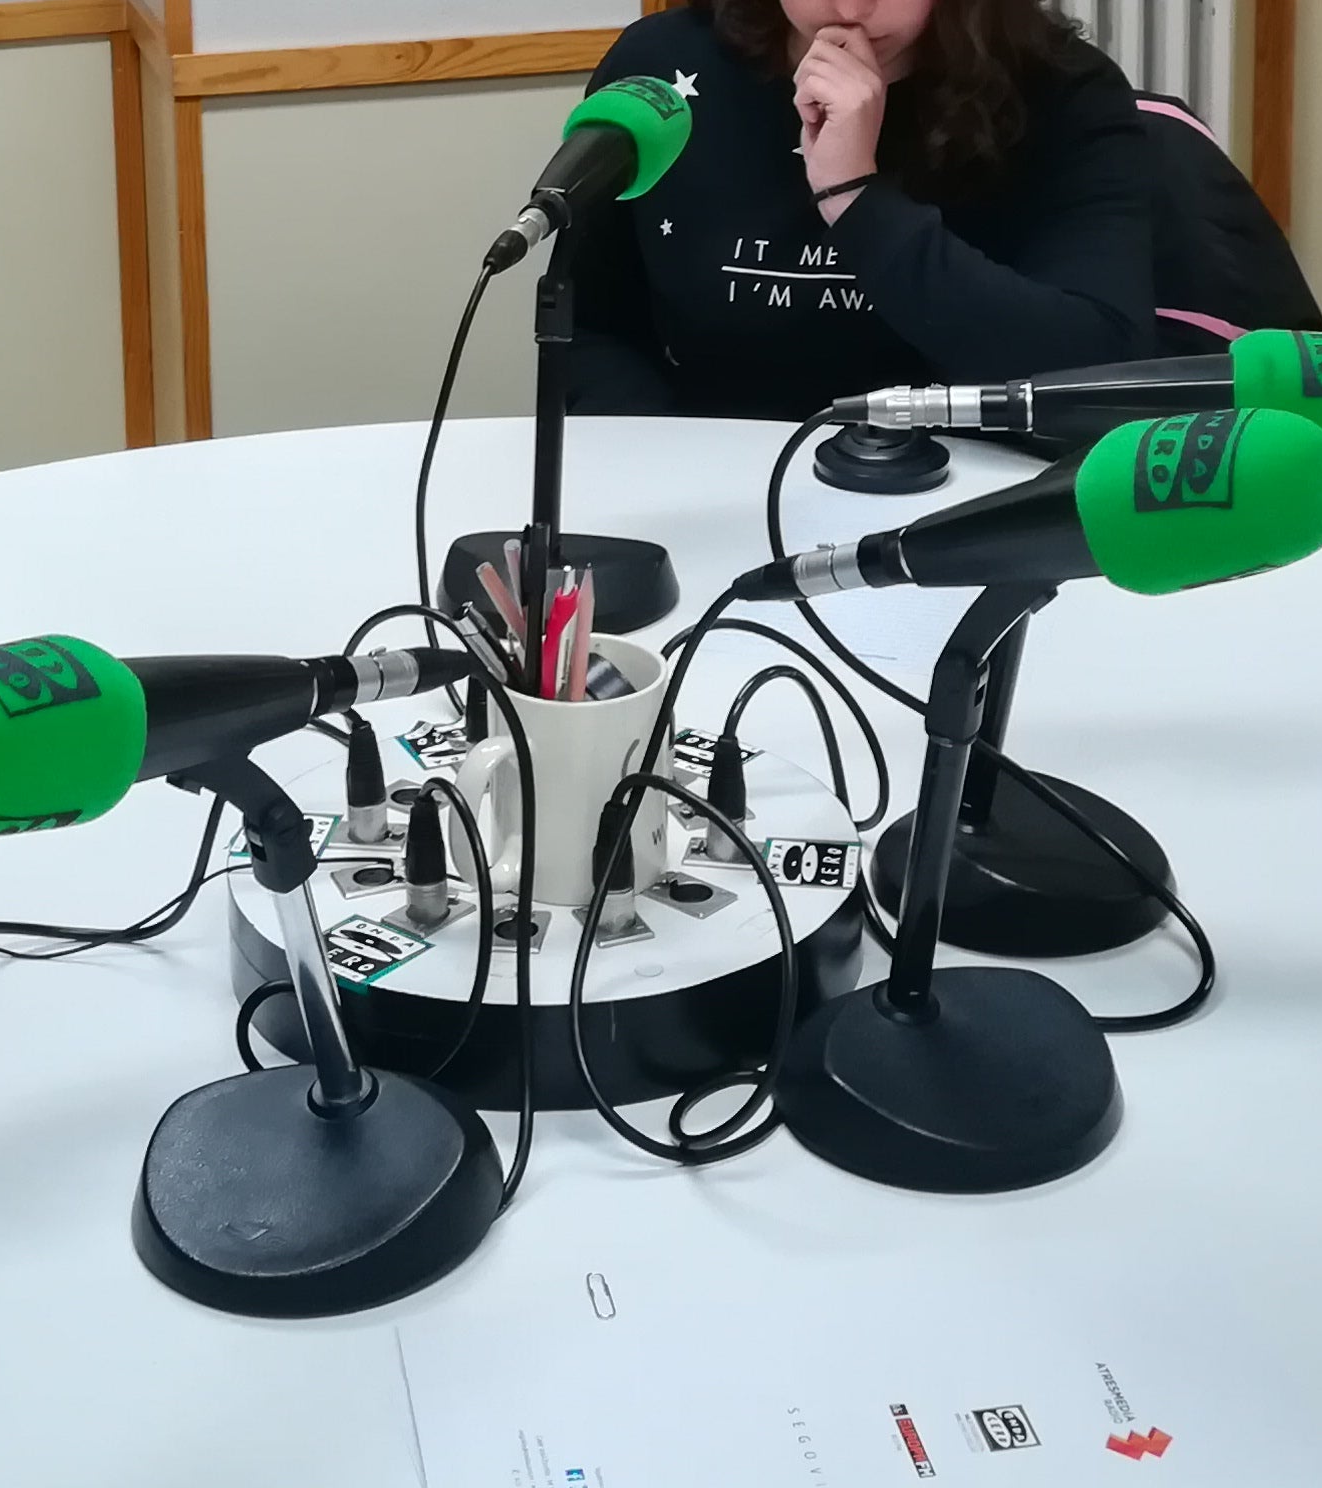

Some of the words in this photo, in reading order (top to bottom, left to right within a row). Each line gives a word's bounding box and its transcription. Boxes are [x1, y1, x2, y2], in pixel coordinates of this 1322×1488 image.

[733, 237, 770, 262] IT
[728, 280, 792, 308] I'M
[818, 287, 874, 312] AW
[1151, 413, 1197, 484] ERO
[1193, 408, 1236, 479] NDA
[819, 847, 843, 886] CERO
[355, 922, 415, 949] ONDA
[327, 947, 376, 972] ERO
[1094, 1361, 1137, 1423] ATRESMEDIA
[1001, 1410, 1028, 1444] ONDA
